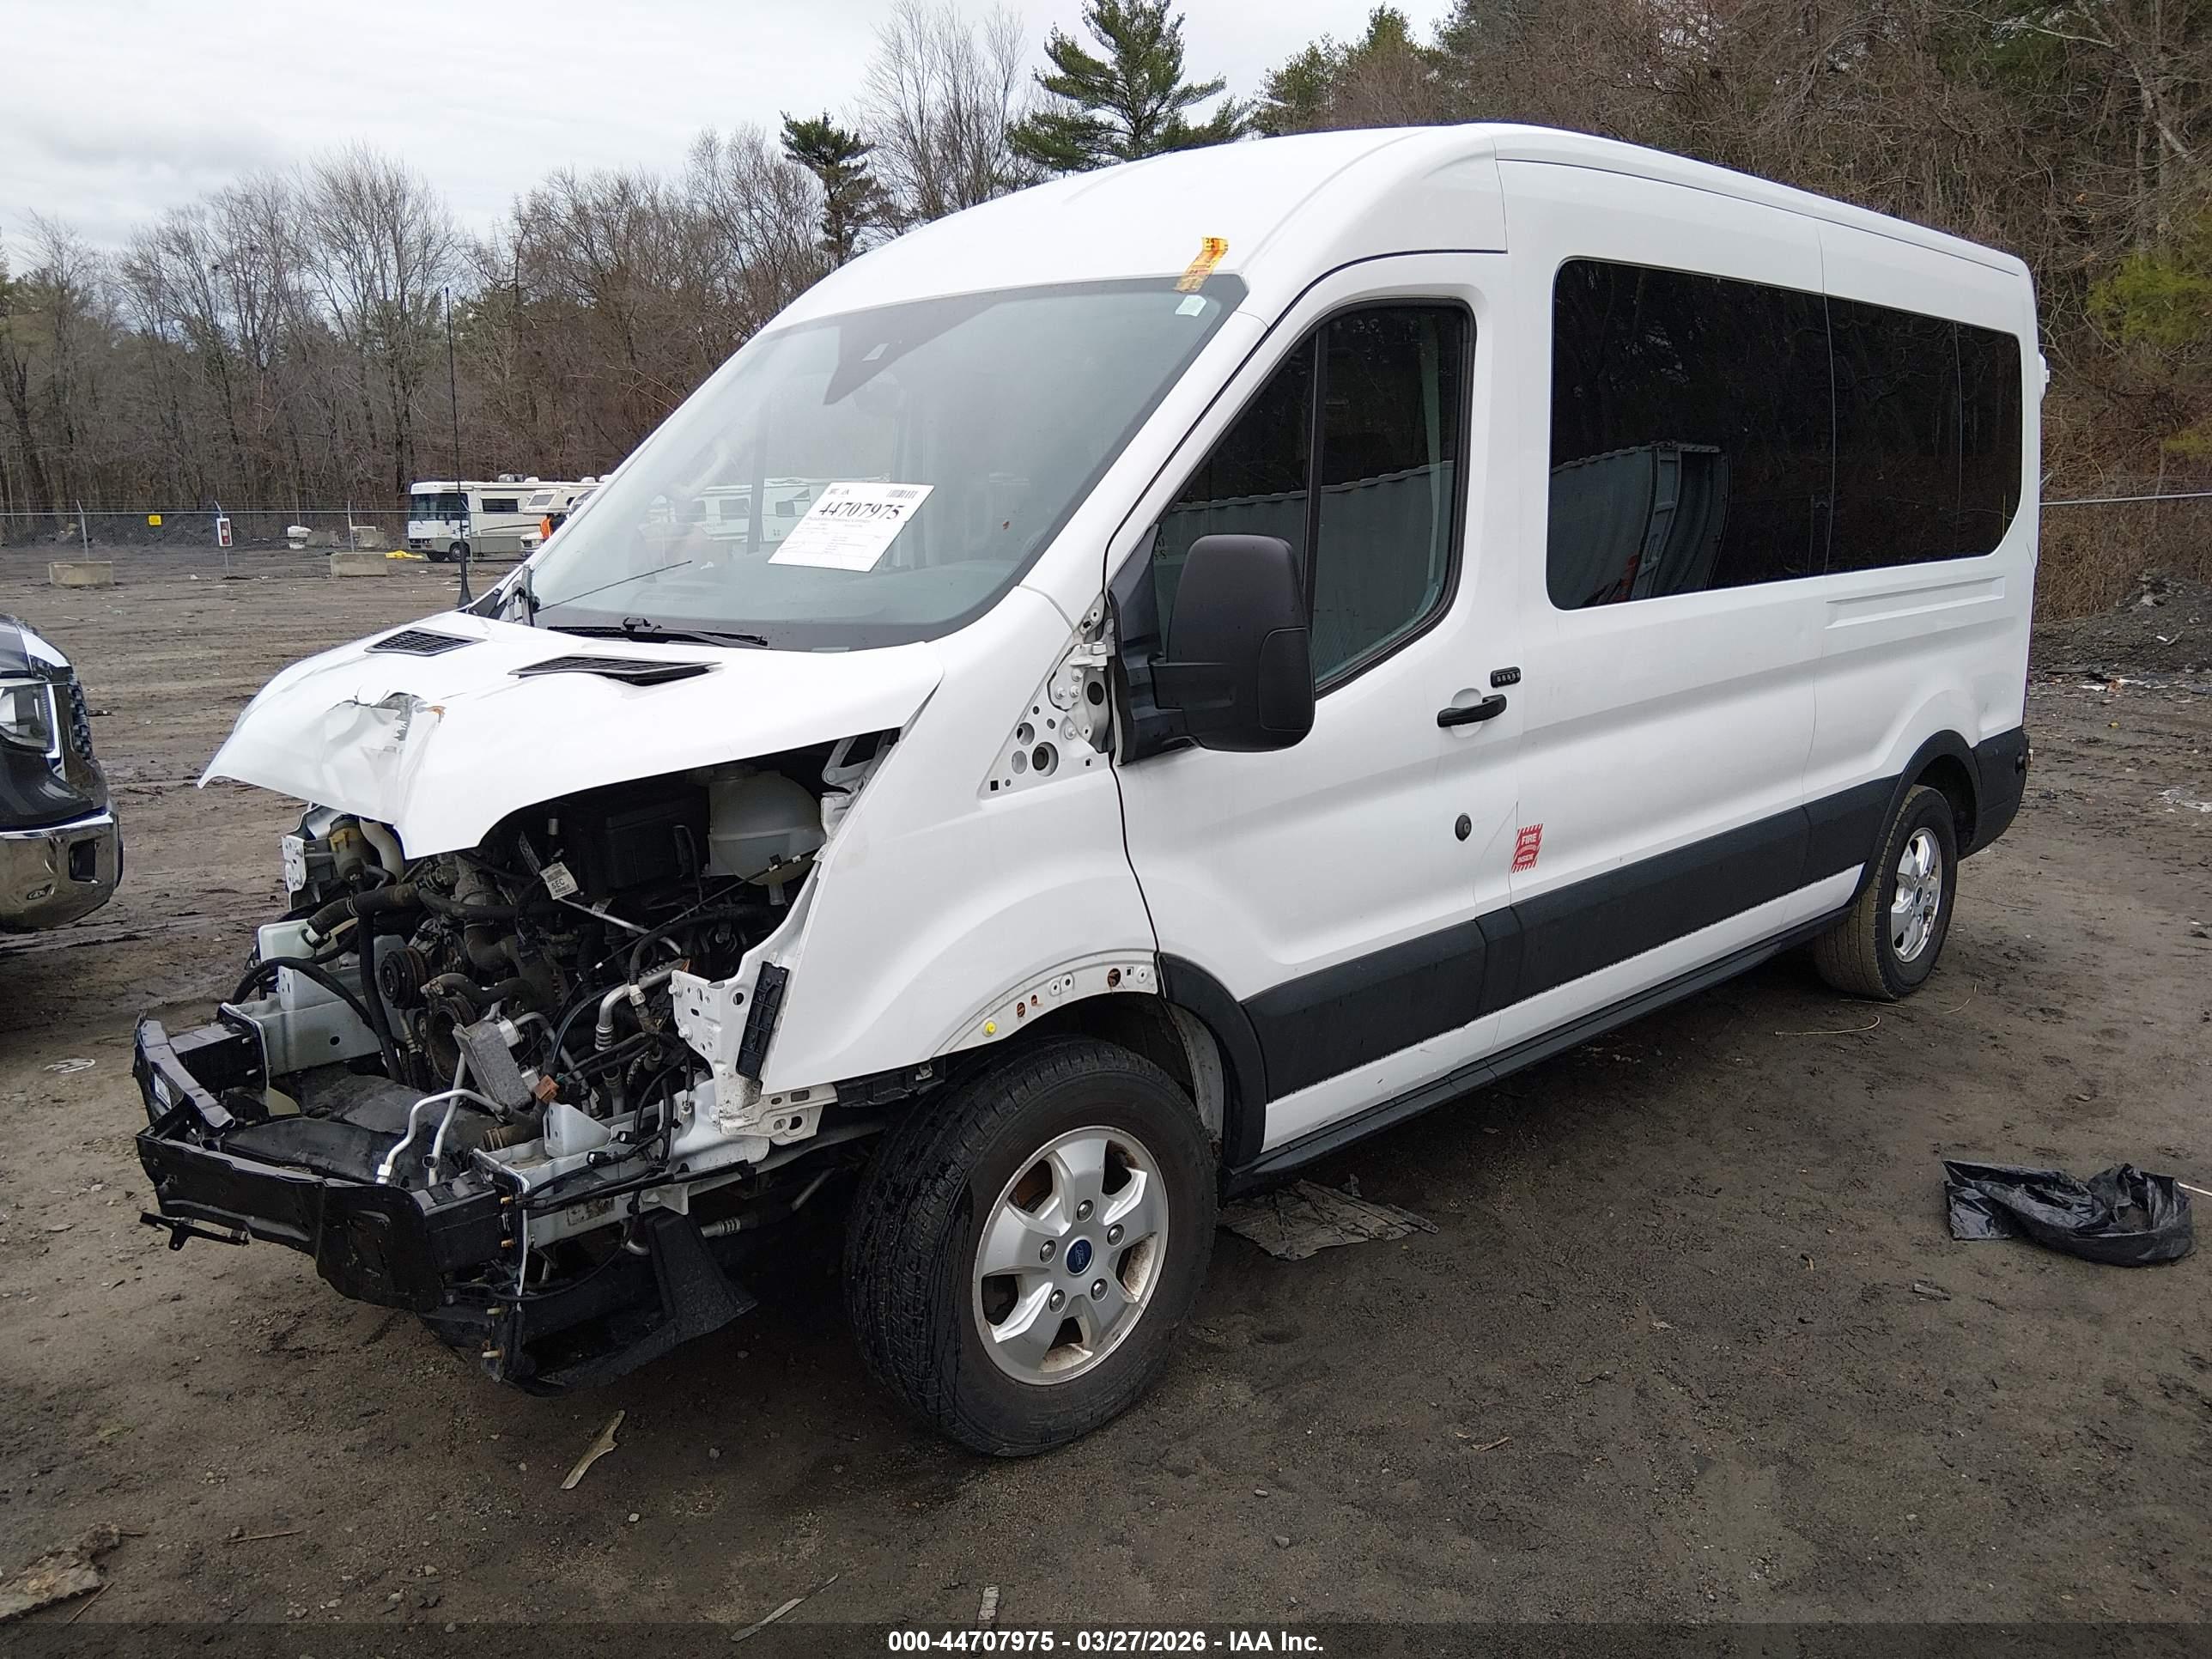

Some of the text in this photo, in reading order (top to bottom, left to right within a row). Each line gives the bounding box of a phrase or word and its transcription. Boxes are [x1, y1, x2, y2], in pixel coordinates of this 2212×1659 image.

[818, 501, 906, 520] 44707975
[1521, 833, 1537, 845] FIRE
[551, 878, 565, 890] SEC
